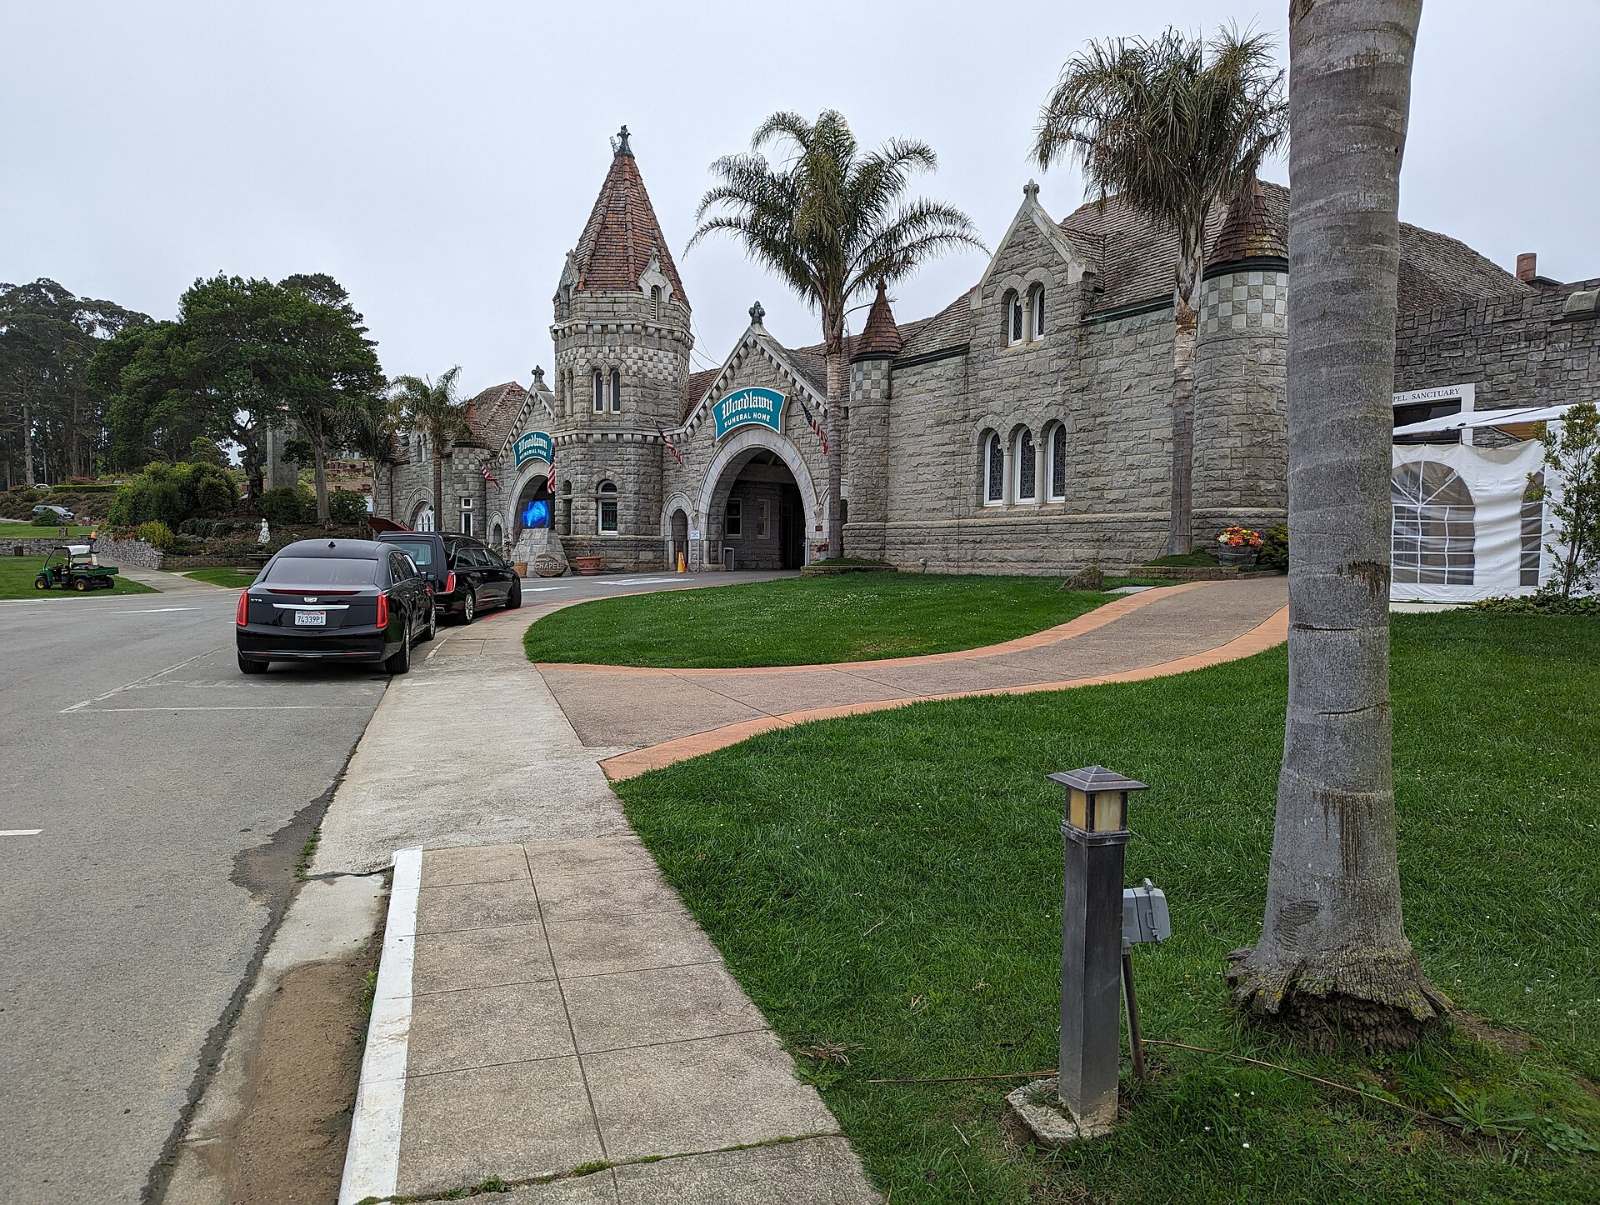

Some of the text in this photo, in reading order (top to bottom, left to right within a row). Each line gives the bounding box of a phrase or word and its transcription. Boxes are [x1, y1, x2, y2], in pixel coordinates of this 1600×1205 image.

[1393, 388, 1460, 402] PEL SANCTUARY
[722, 391, 773, 420] Woodlawn
[724, 412, 771, 428] FUNERAL HOME
